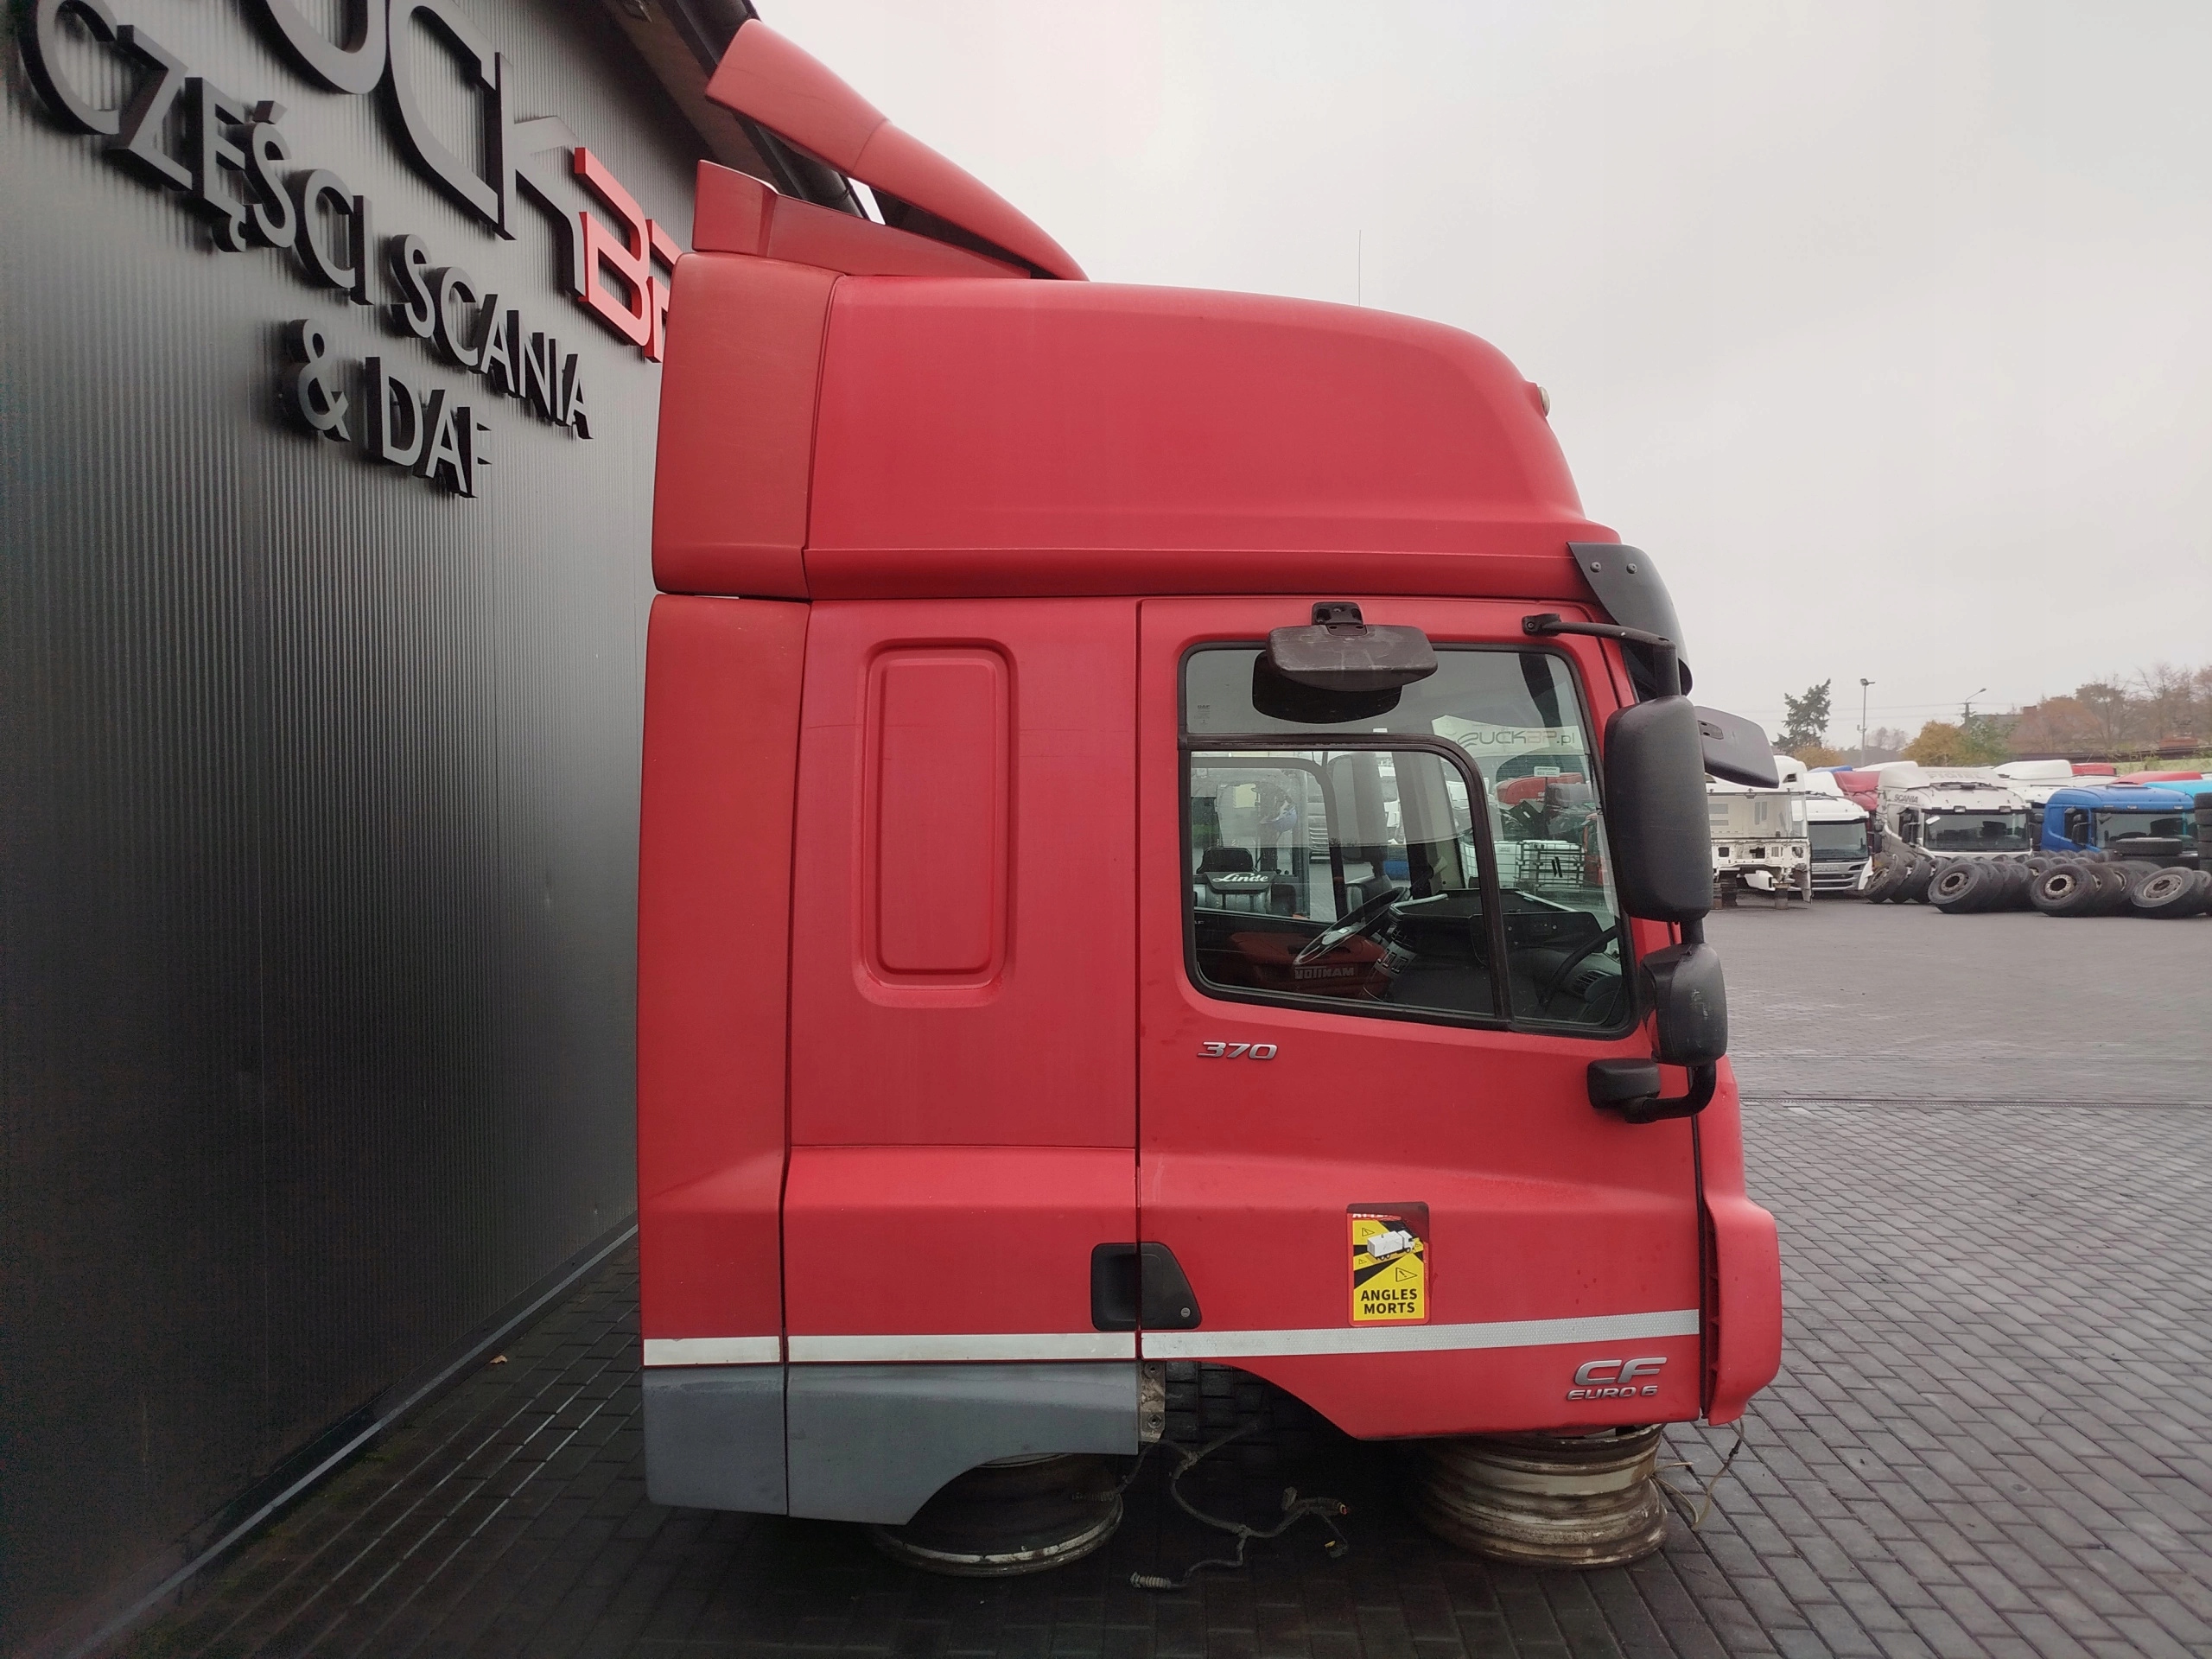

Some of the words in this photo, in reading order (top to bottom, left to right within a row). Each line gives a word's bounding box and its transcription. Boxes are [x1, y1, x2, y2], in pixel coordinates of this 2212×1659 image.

[19, 0, 373, 305] CZĘŚCI
[389, 233, 593, 439] SCANIA
[281, 318, 351, 442] &
[365, 356, 493, 498] DAF
[1894, 794, 1918, 804] SCANIA
[1211, 872, 1269, 882] Linde
[1197, 1041, 1278, 1060] 370
[1360, 1288, 1418, 1302] ANGLES
[1363, 1302, 1415, 1315] MORTS
[1573, 1357, 1668, 1386] CF
[1567, 1386, 1637, 1401] EURO
[1641, 1385, 1658, 1396] 6
